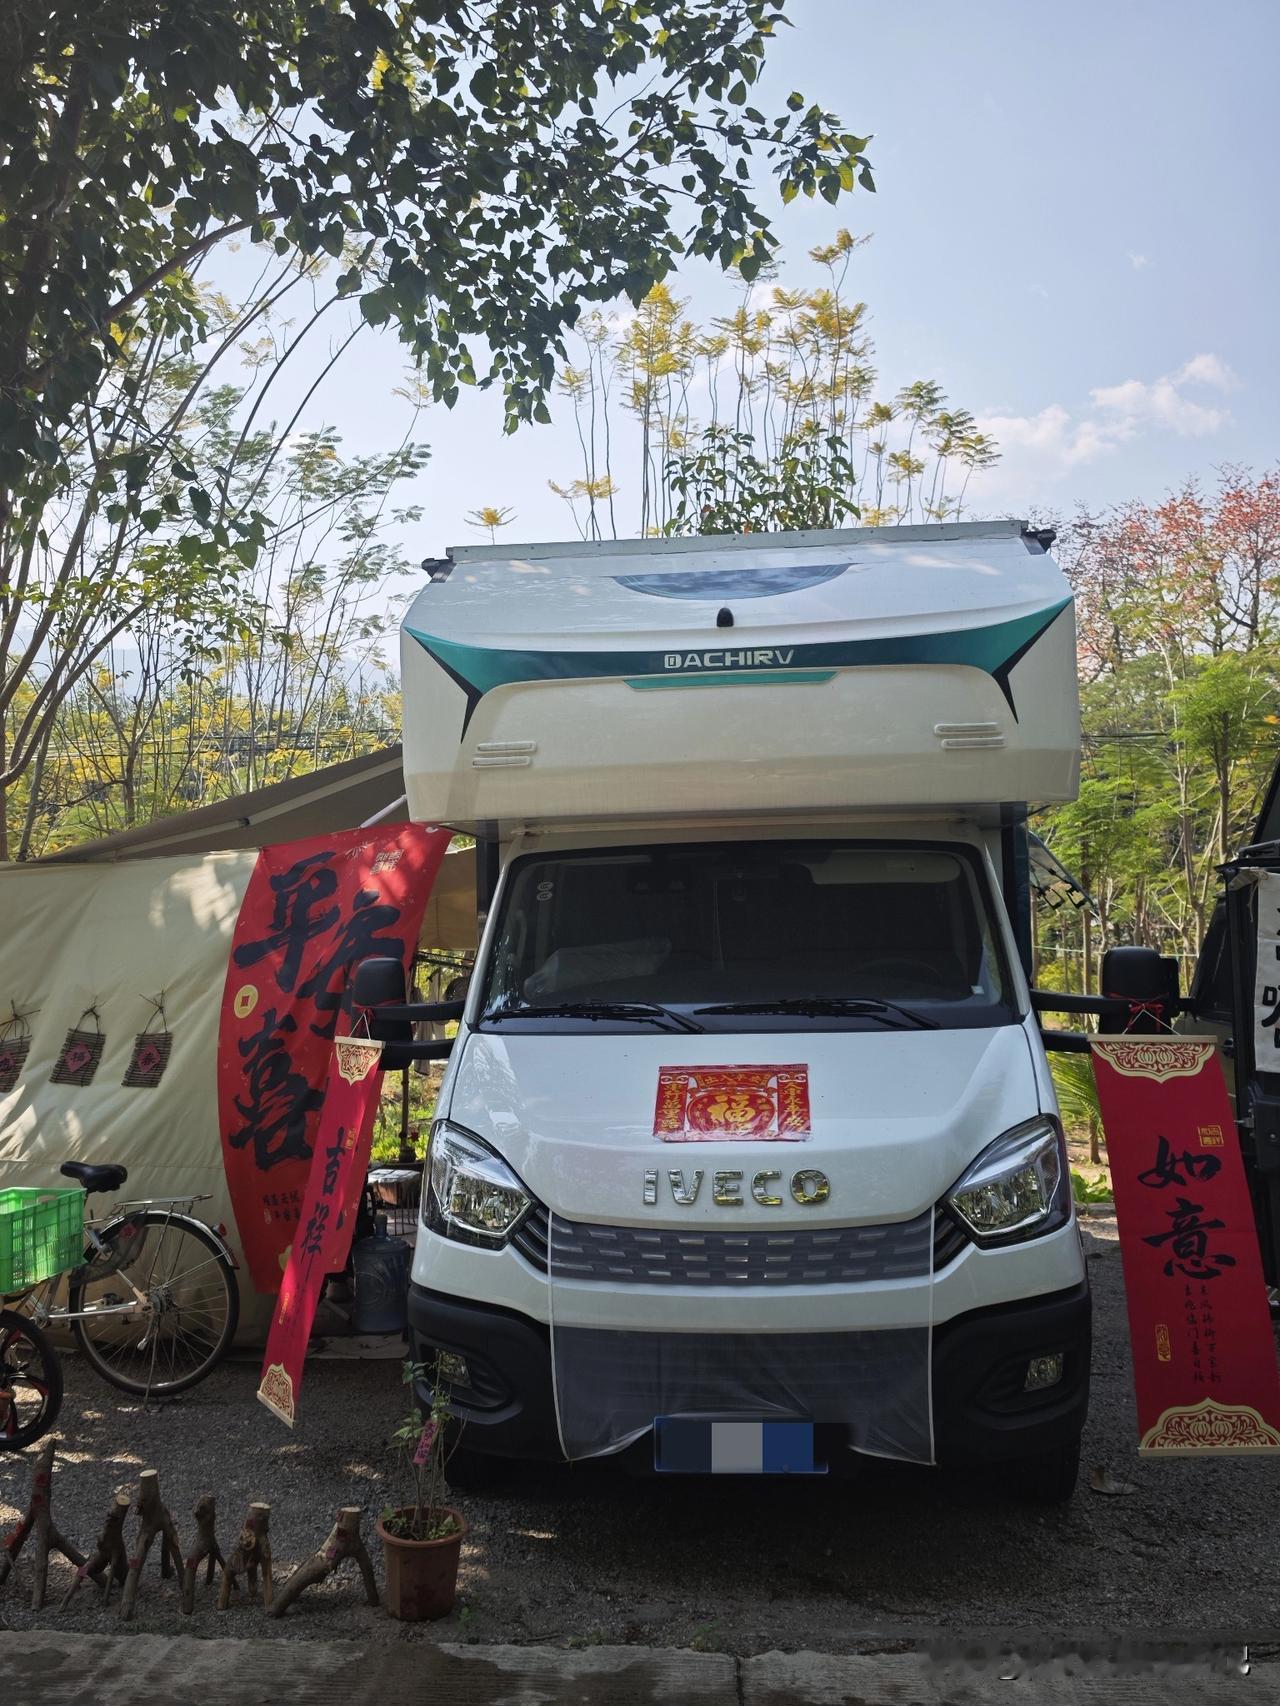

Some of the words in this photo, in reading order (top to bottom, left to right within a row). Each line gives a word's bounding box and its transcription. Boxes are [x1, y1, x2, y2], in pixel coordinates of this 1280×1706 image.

[664, 649, 794, 669] DACHIRV
[707, 1093, 757, 1124] 福
[300, 1126, 345, 1282] 吉祥
[642, 1168, 831, 1206] IVECO
[1137, 1135, 1237, 1281] 如意
